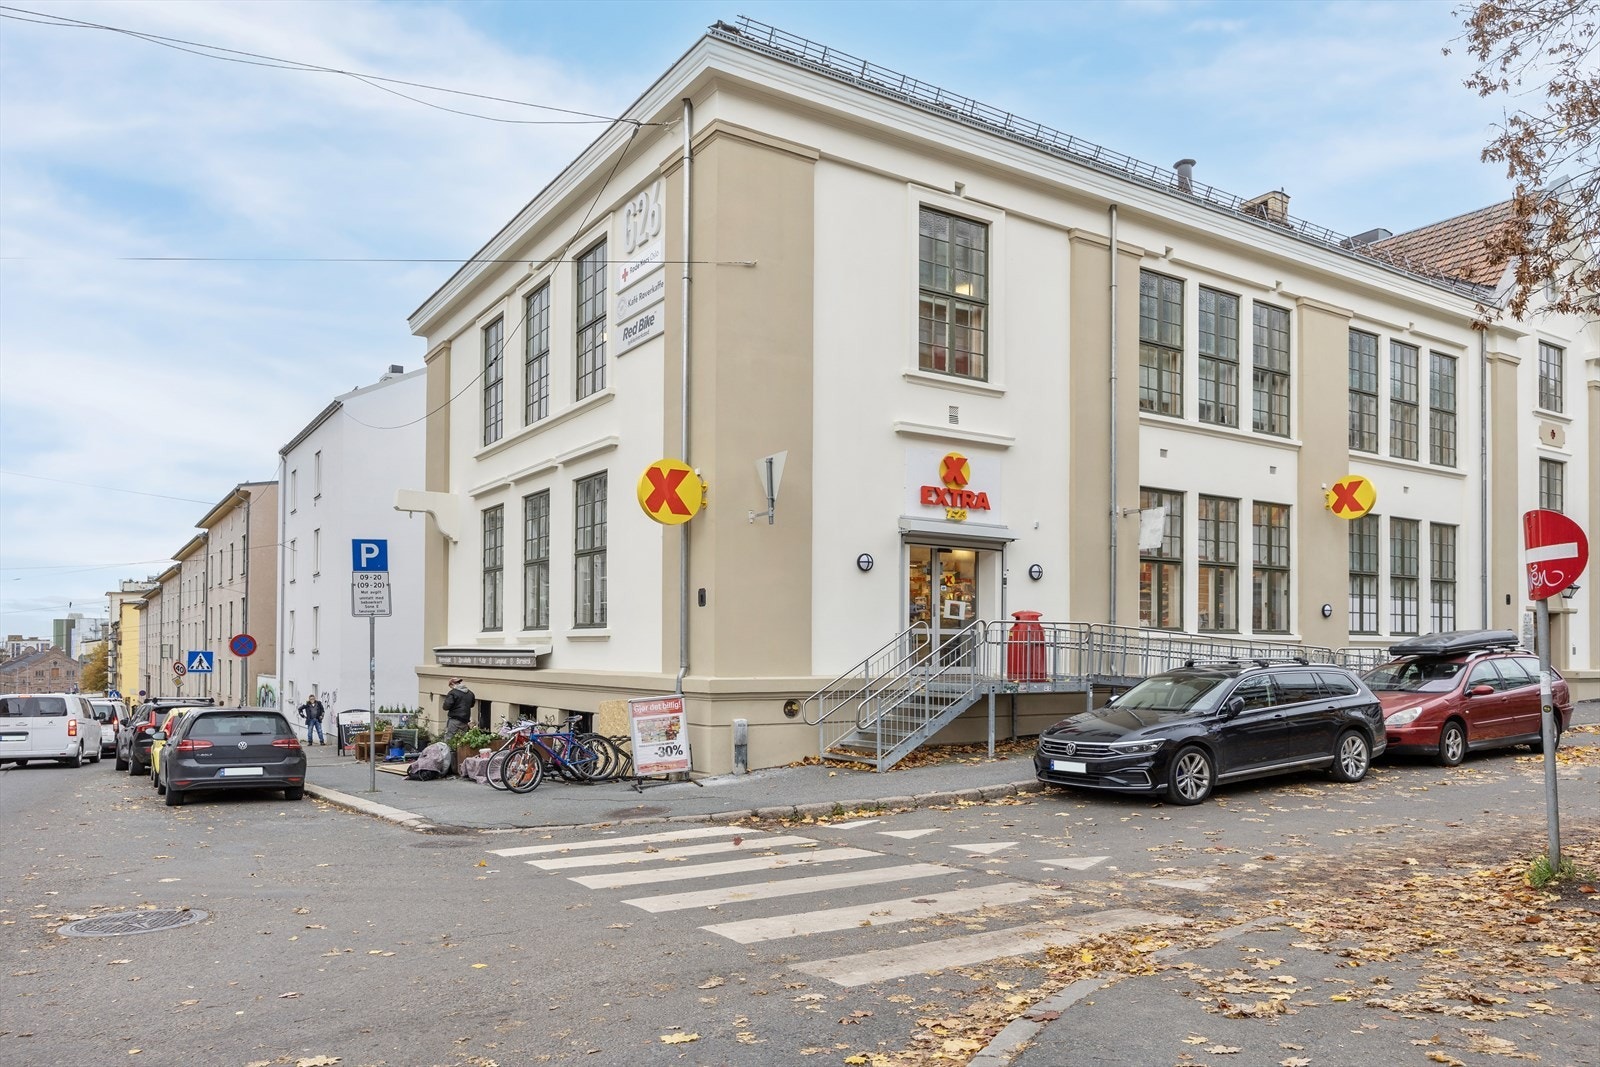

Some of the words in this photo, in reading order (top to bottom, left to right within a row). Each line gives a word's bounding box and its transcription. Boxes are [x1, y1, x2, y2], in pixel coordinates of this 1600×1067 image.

[628, 295, 638, 307] Kafé
[623, 320, 638, 341] Red
[639, 314, 655, 332] Bike
[943, 456, 968, 485] X
[645, 466, 692, 515] X
[920, 486, 991, 510] EXTRA
[1332, 480, 1365, 514] X
[361, 543, 379, 567] P
[176, 664, 184, 674] 40
[634, 704, 648, 714] Gjør
[650, 703, 662, 711] det
[662, 701, 681, 710] billig!
[654, 744, 684, 758] -30%
